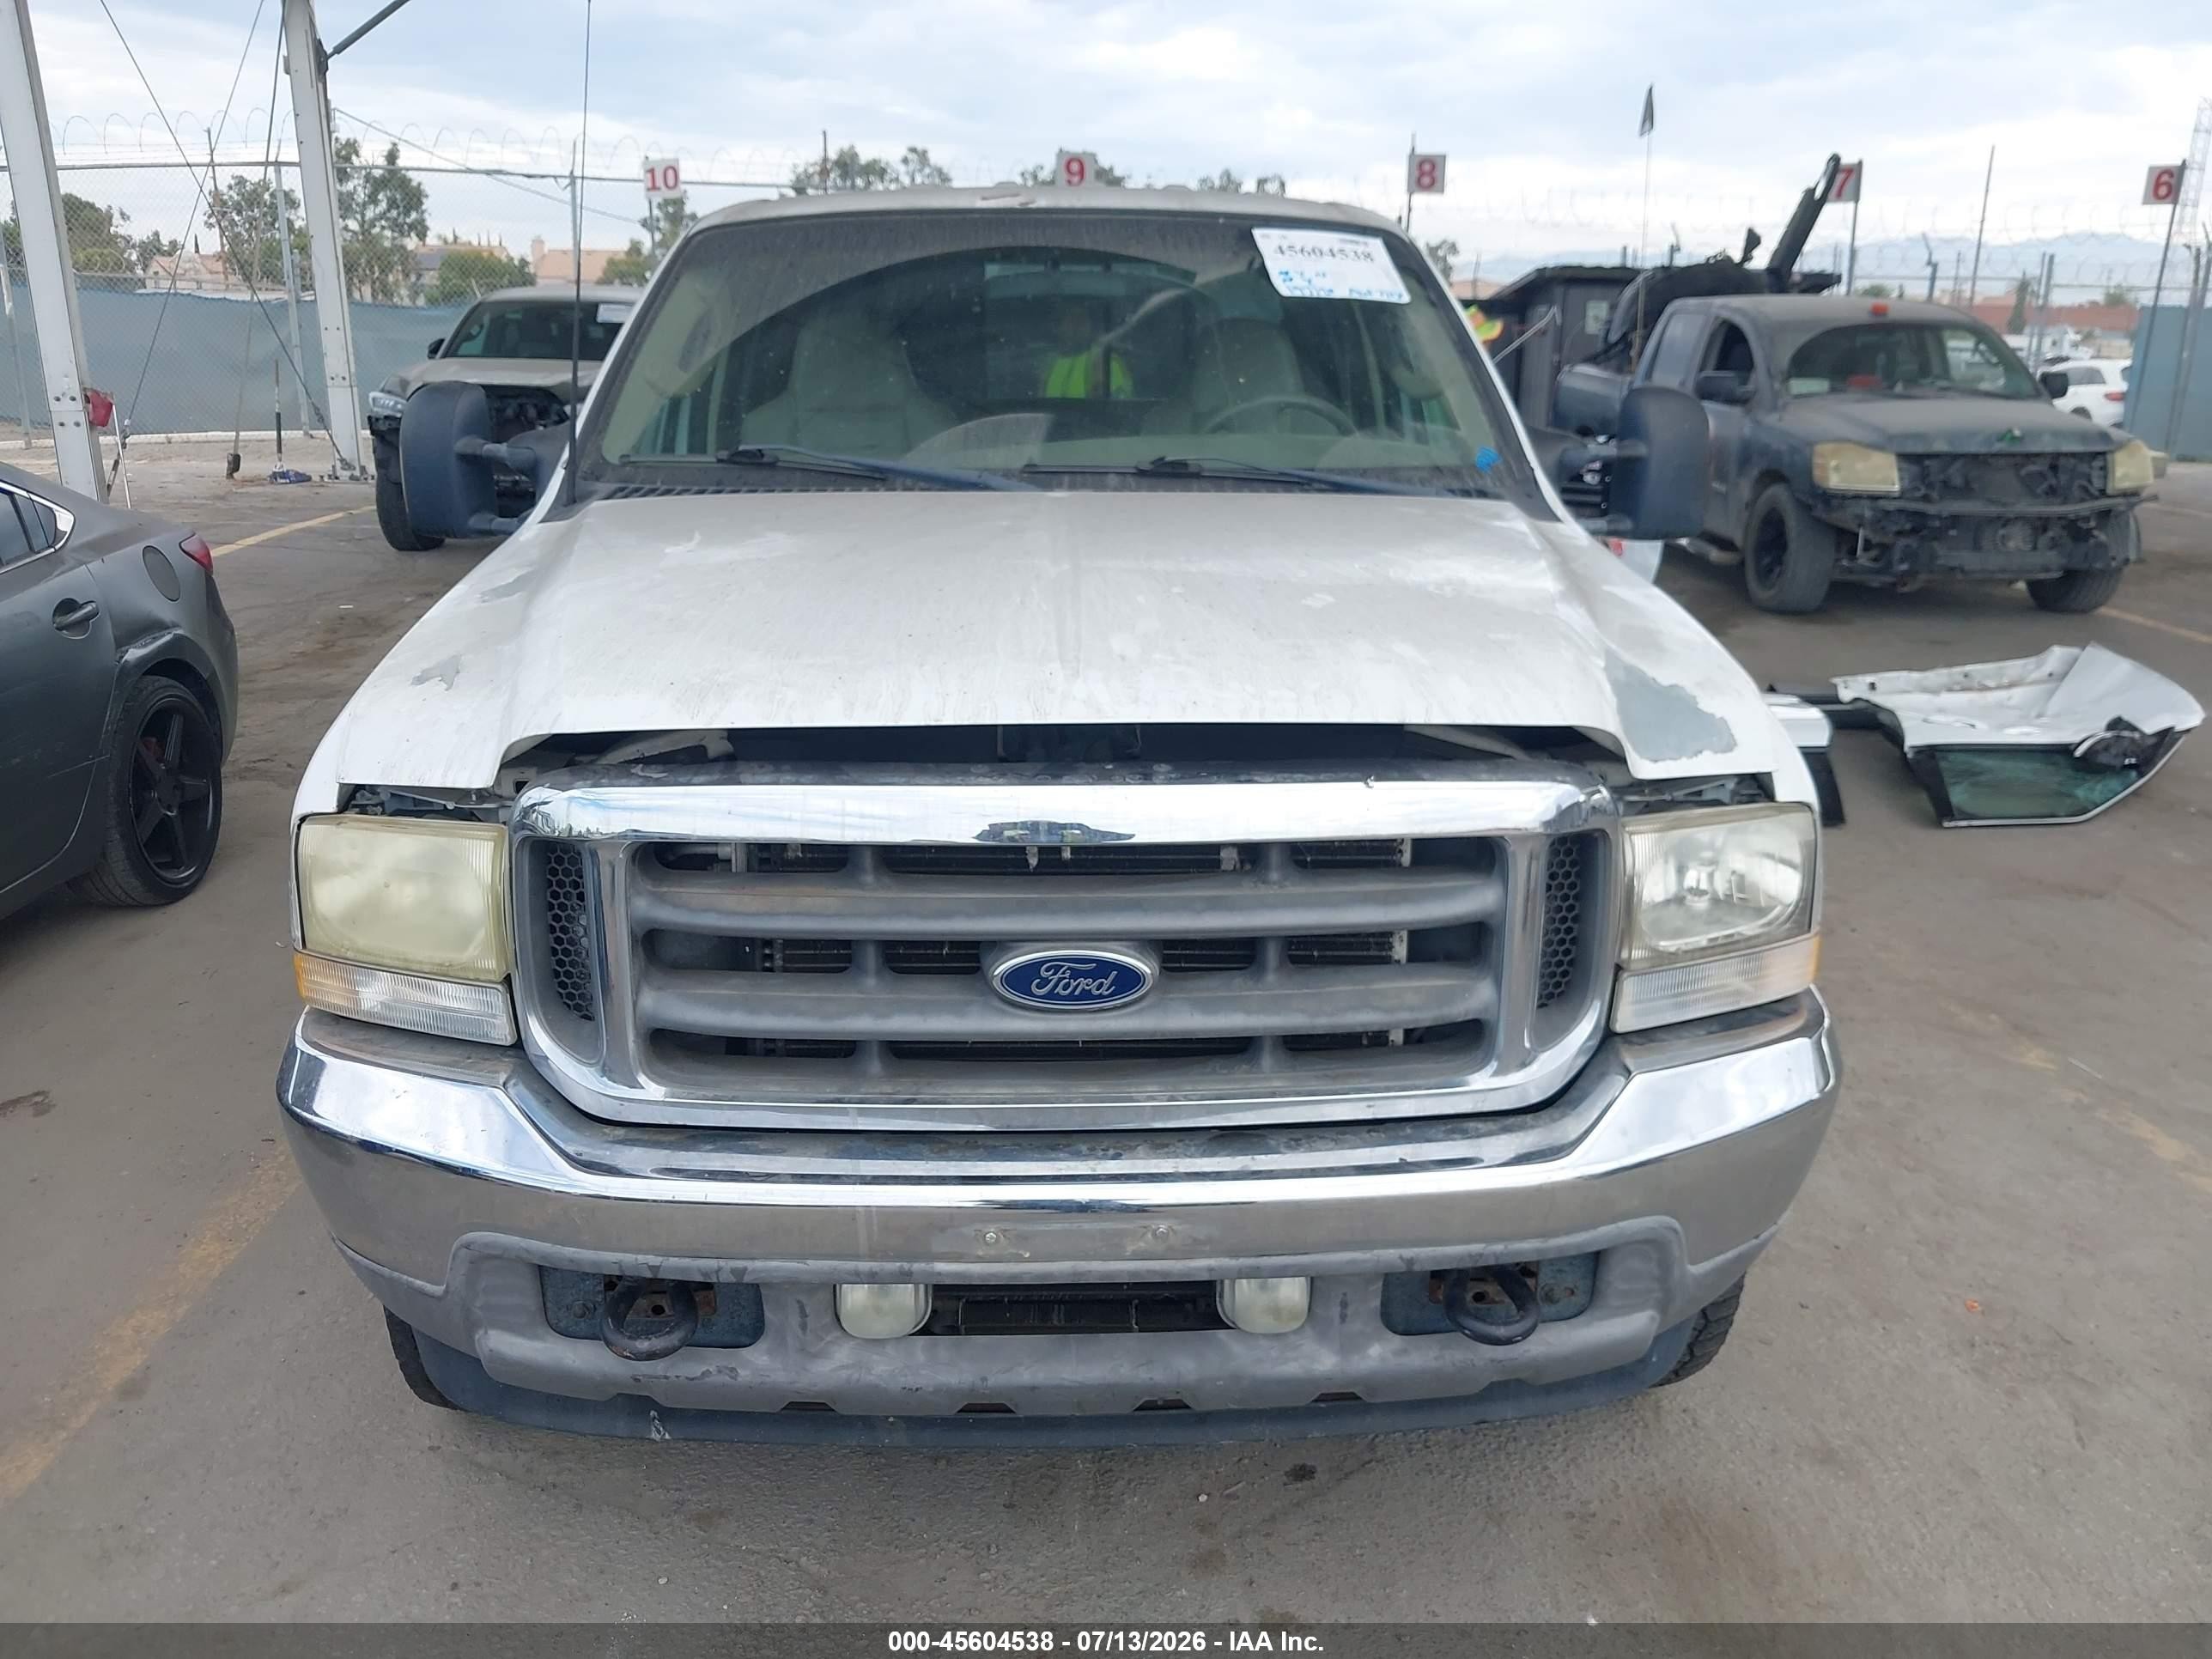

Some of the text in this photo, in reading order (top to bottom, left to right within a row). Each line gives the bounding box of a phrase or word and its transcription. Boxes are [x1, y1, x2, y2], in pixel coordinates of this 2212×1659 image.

[645, 165, 678, 191] 10
[1066, 157, 1085, 186] 9
[1417, 158, 1436, 190] 8
[1836, 167, 1854, 198] 7
[2152, 168, 2174, 201] 6
[1274, 244, 1375, 264] 45604538
[1030, 961, 1118, 996] Ford
